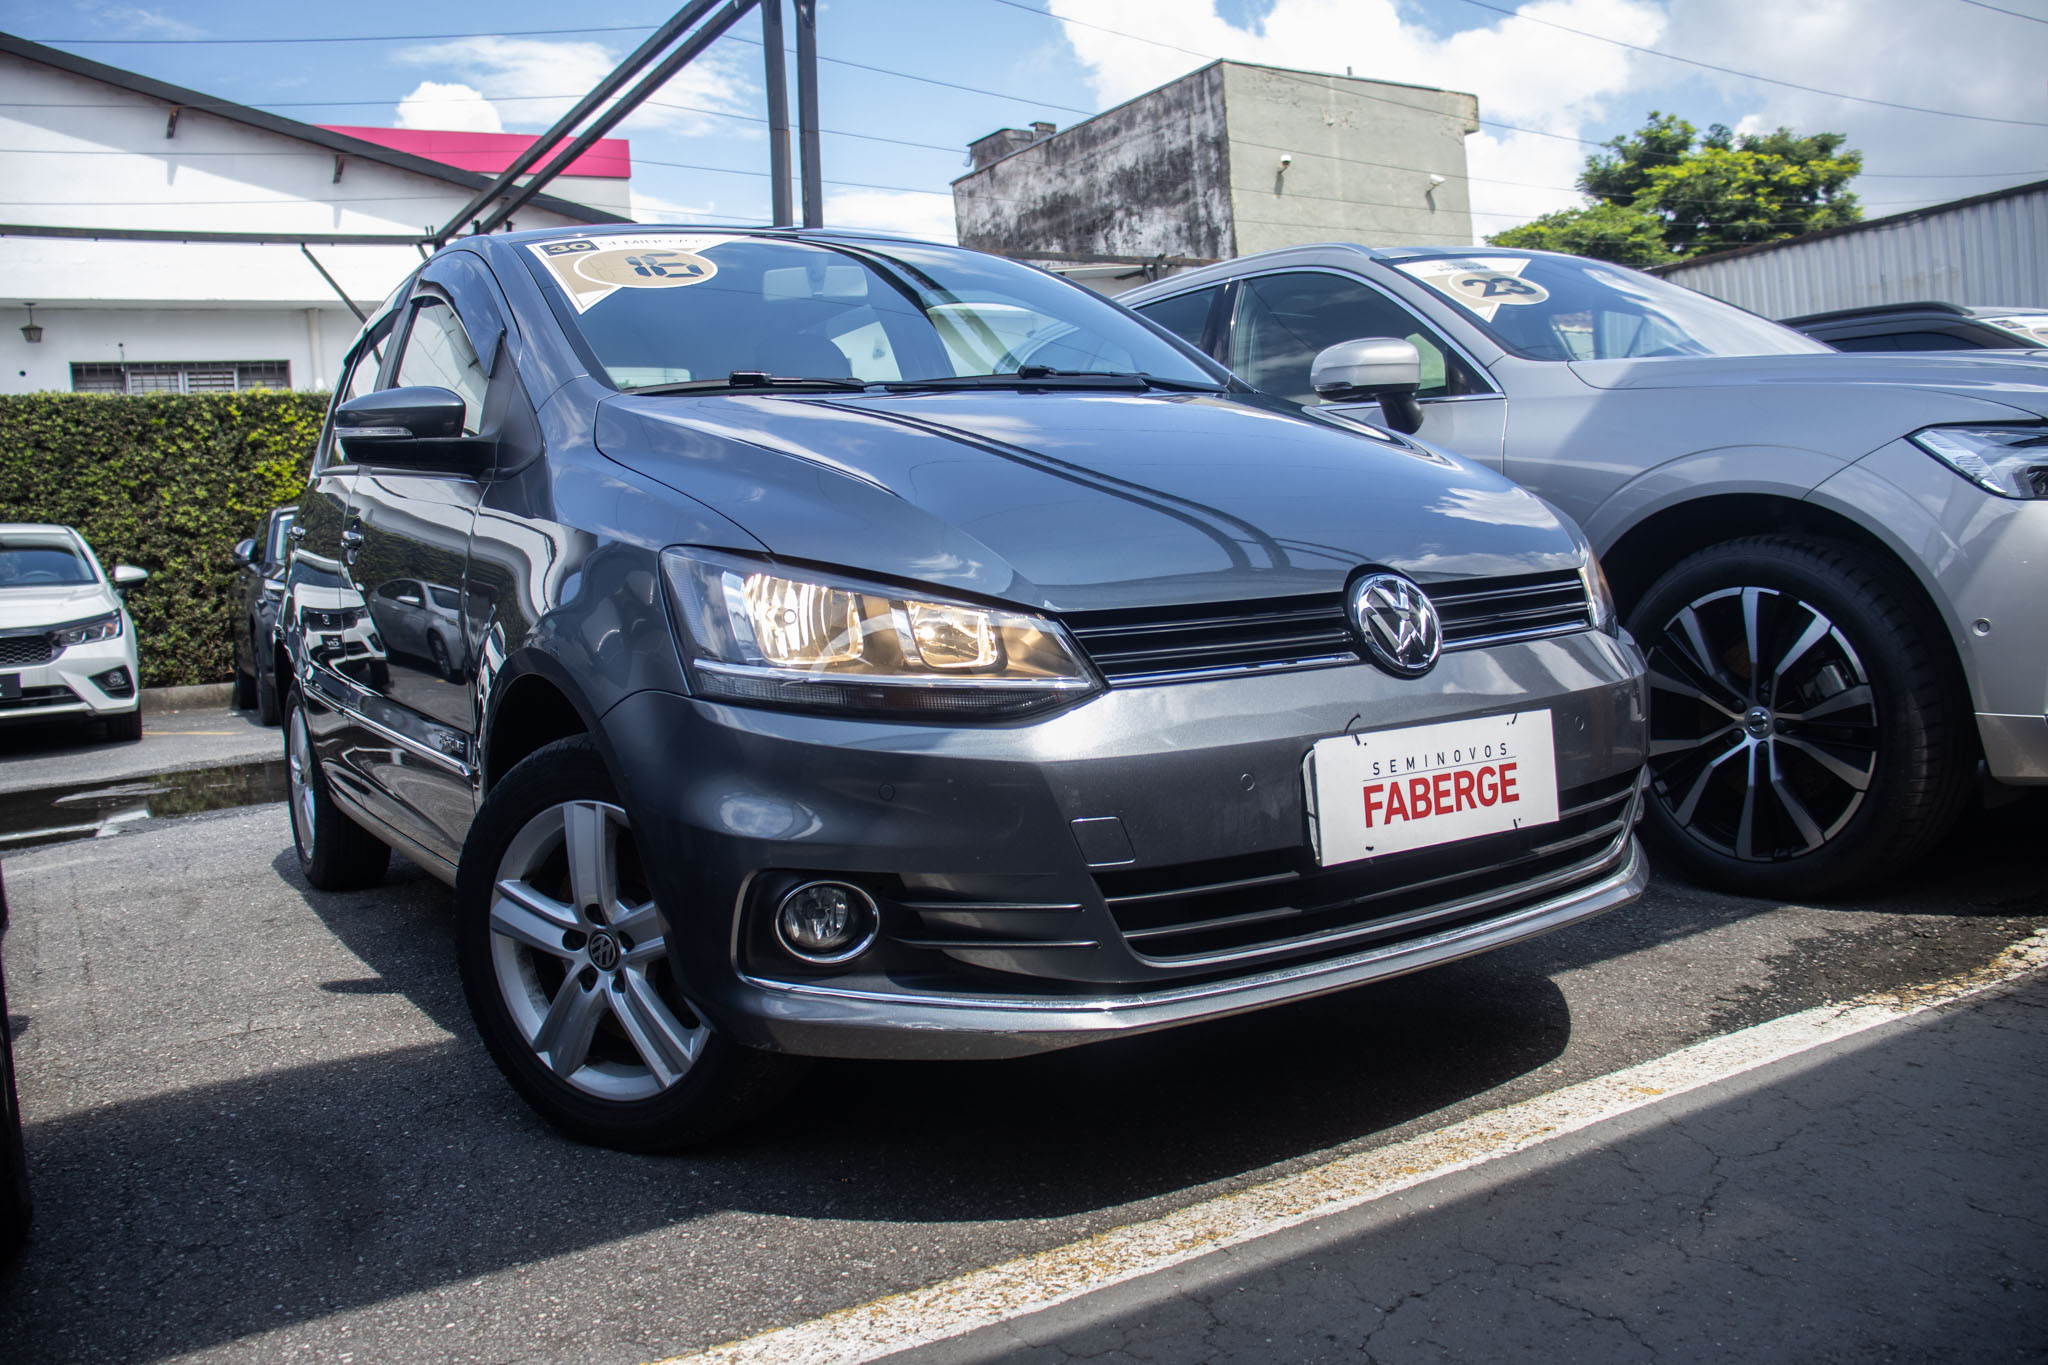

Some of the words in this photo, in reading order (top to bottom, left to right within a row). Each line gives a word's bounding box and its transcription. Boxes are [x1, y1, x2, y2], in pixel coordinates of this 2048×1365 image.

[549, 242, 592, 253] 30
[624, 253, 705, 278] 16
[1461, 277, 1537, 297] 23
[1372, 742, 1507, 776] SEMINOVOS
[1363, 762, 1520, 828] FABERGE
